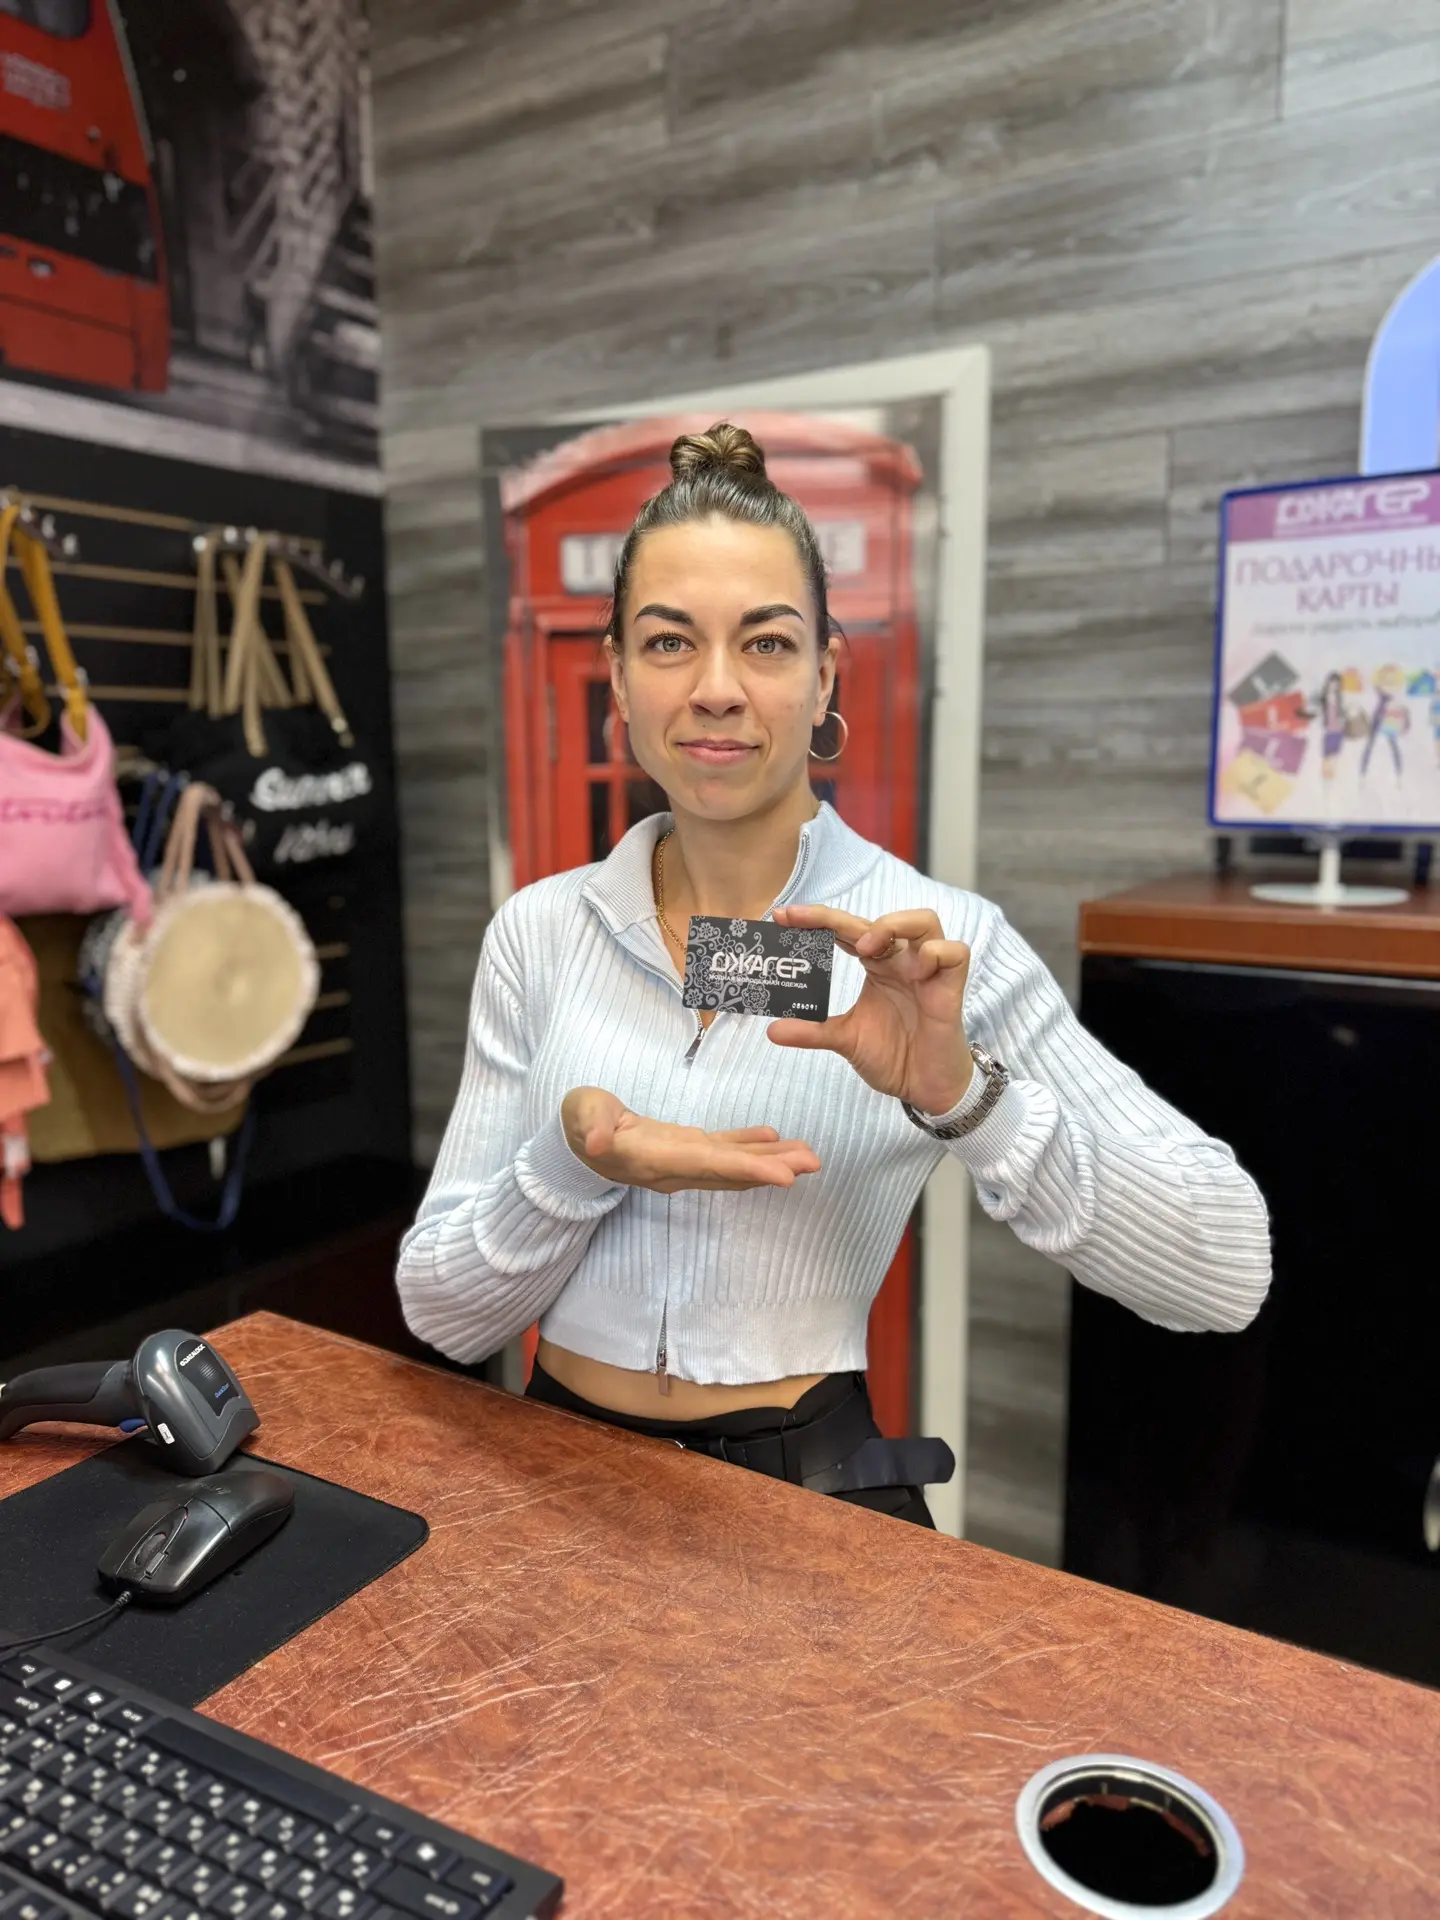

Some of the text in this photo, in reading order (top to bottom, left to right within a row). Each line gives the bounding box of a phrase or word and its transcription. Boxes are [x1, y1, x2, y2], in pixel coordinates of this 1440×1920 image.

[1296, 581, 1399, 613] КАРТЫ
[708, 951, 811, 979] ДЖАГЕР
[780, 980, 808, 989] ОДЕЖДА
